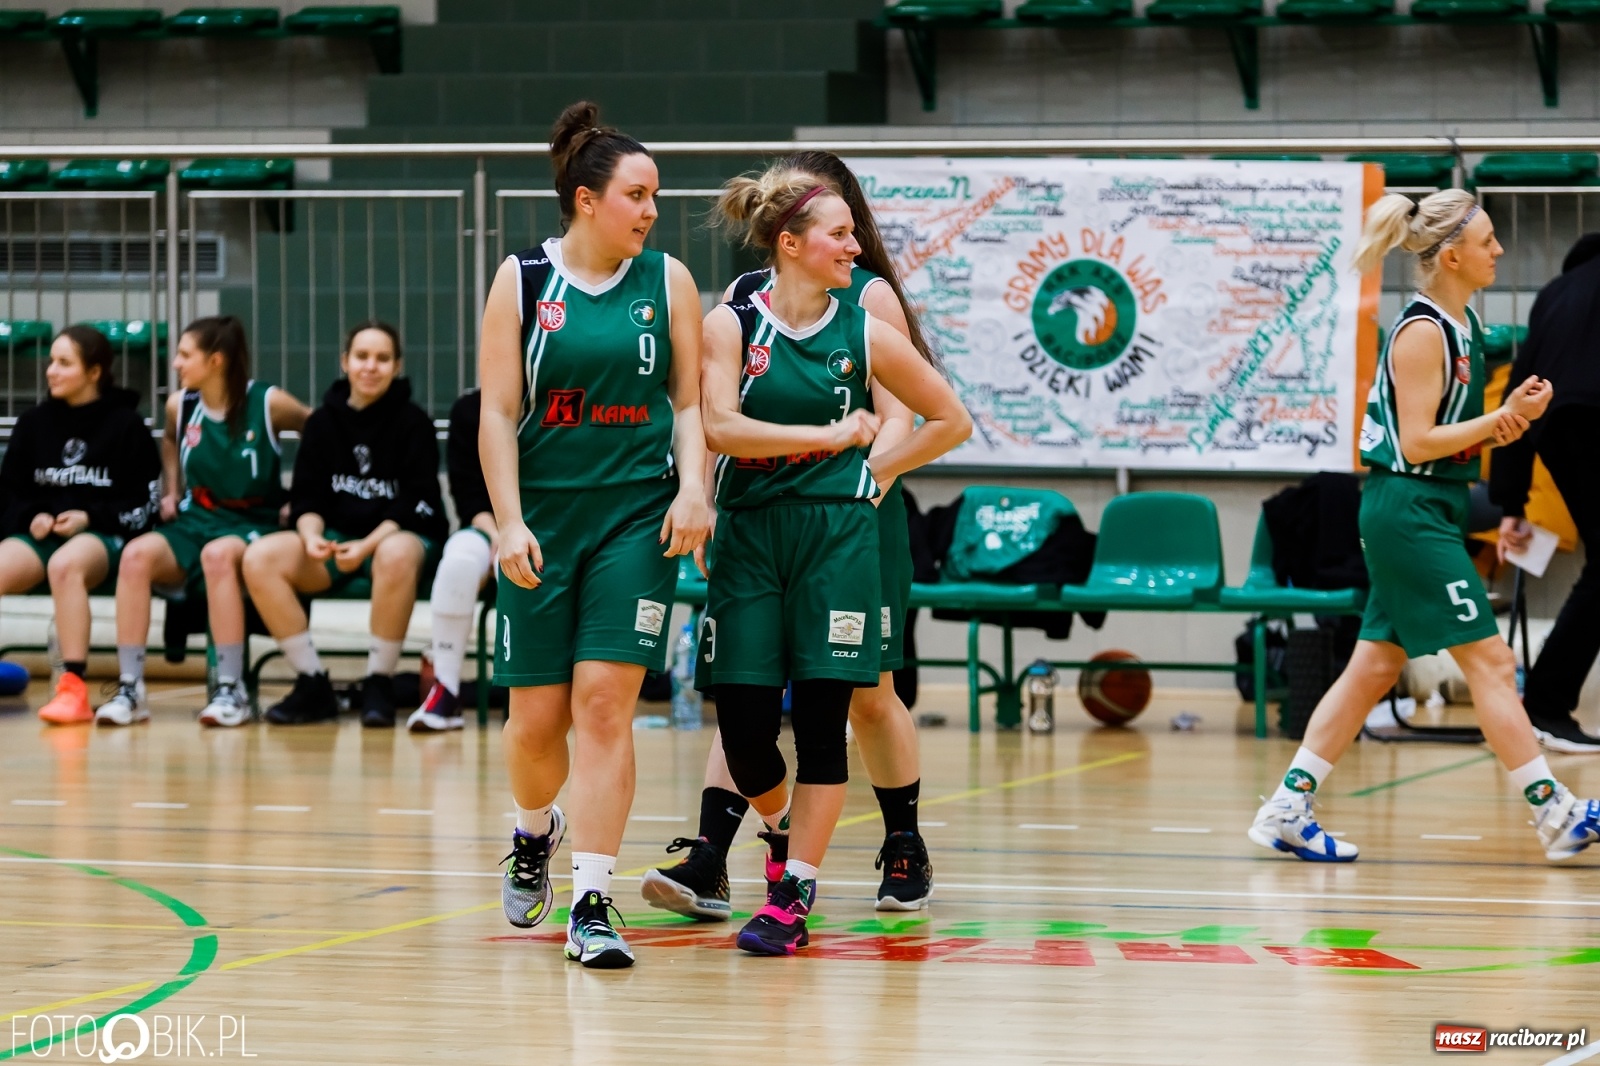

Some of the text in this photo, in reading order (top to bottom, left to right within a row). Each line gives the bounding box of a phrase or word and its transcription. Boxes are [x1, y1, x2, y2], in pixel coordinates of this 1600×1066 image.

[1003, 230, 1071, 313] GRAMY
[1080, 227, 1126, 263] DLA
[1125, 253, 1168, 314] WAS
[638, 333, 656, 375] 9
[830, 386, 851, 429] 3
[1445, 579, 1479, 622] 5
[832, 650, 859, 659] COLO
